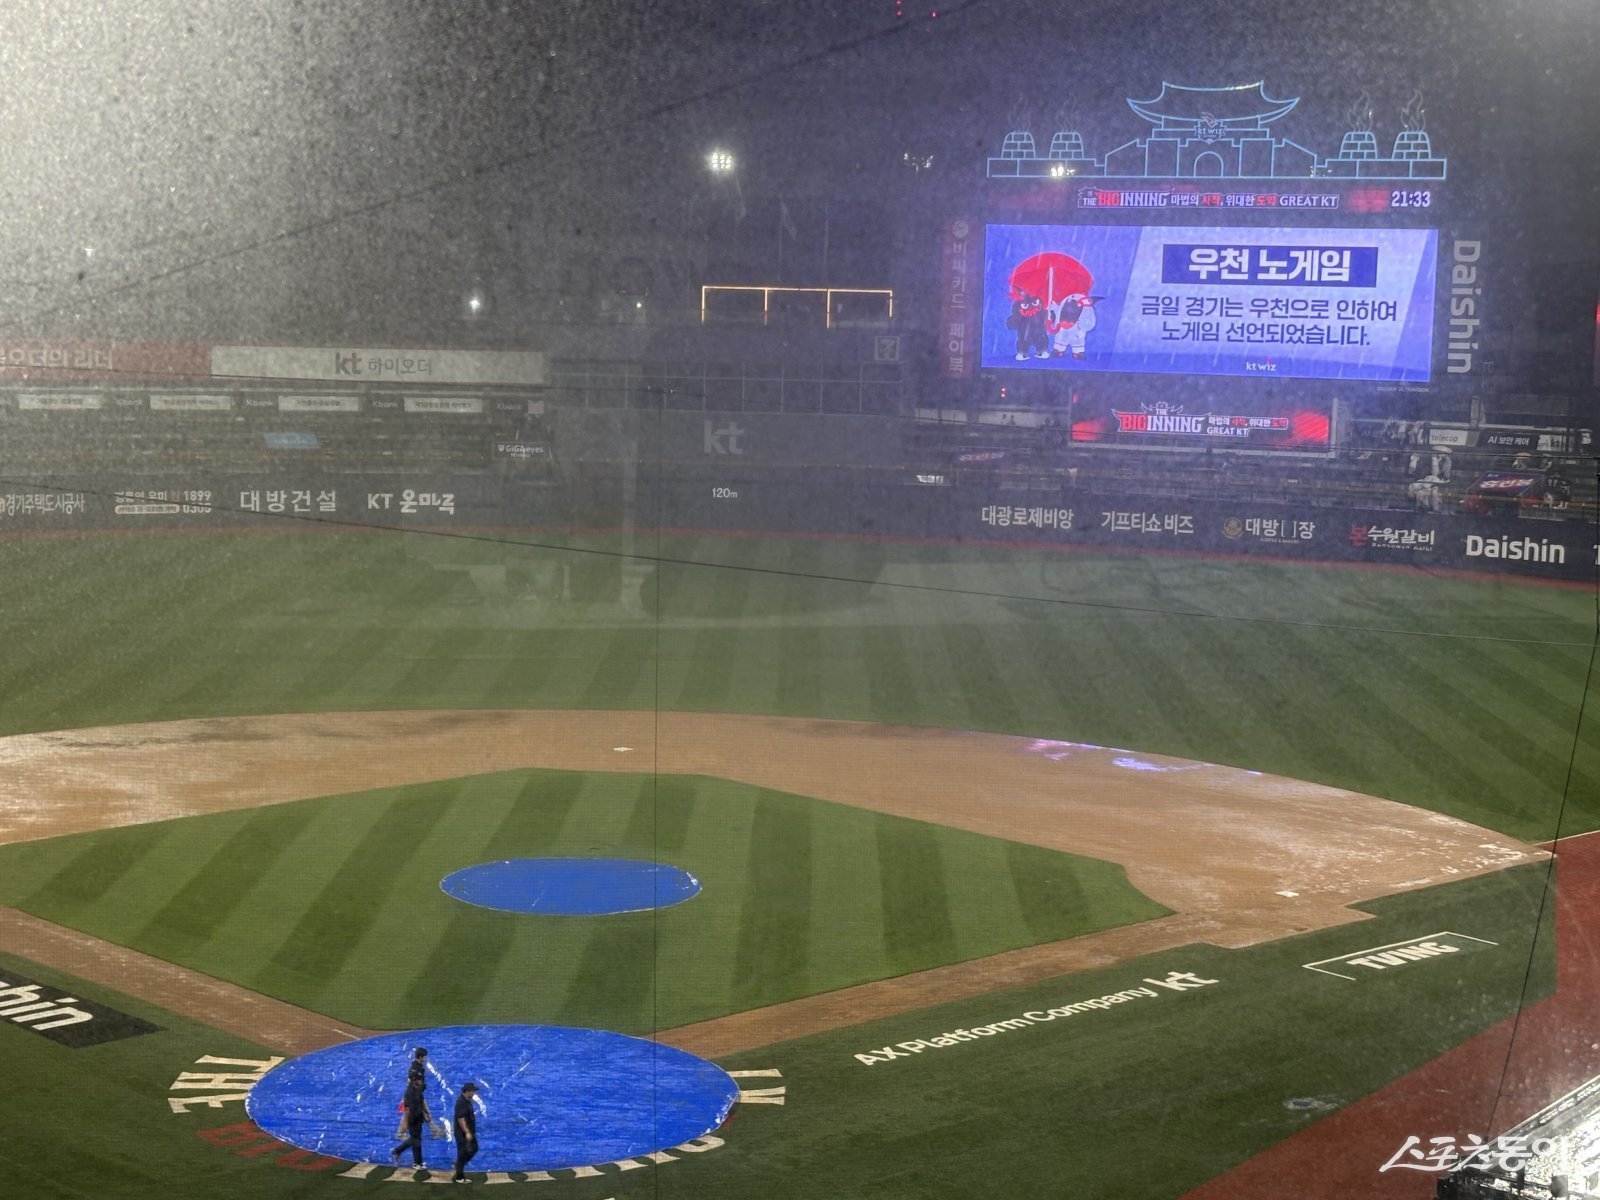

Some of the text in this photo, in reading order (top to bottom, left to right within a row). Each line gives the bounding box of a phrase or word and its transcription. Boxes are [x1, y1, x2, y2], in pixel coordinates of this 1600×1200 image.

[1083, 197, 1097, 206] THE
[1171, 194, 1199, 207] 마법의
[1225, 195, 1255, 207] 위대한
[1279, 195, 1318, 207] GREAT
[1320, 196, 1337, 207] KT
[1391, 190, 1431, 208] 21:33
[1188, 247, 1351, 283] 우천 노게임
[1141, 295, 1398, 322] 금일 경기는 우천으로 인하여
[1447, 240, 1482, 373] Daishin
[1161, 321, 1371, 346] 노게임 선언되었습니다.
[335, 352, 433, 376] kt 하이오더
[1246, 361, 1276, 372] kt wiz
[703, 420, 745, 455] kt
[1206, 426, 1248, 436] GREAT KT
[183, 490, 212, 501] 1899
[239, 490, 337, 513] 대방건설
[367, 493, 394, 510] KT
[712, 488, 738, 499] 120m
[981, 505, 1074, 530] 대광로제비앙
[1465, 535, 1565, 564] Daishin
[1345, 942, 1460, 970] TVING
[897, 1015, 1035, 1053] Platform
[1022, 985, 1158, 1022] Company
[1142, 971, 1220, 992] kt
